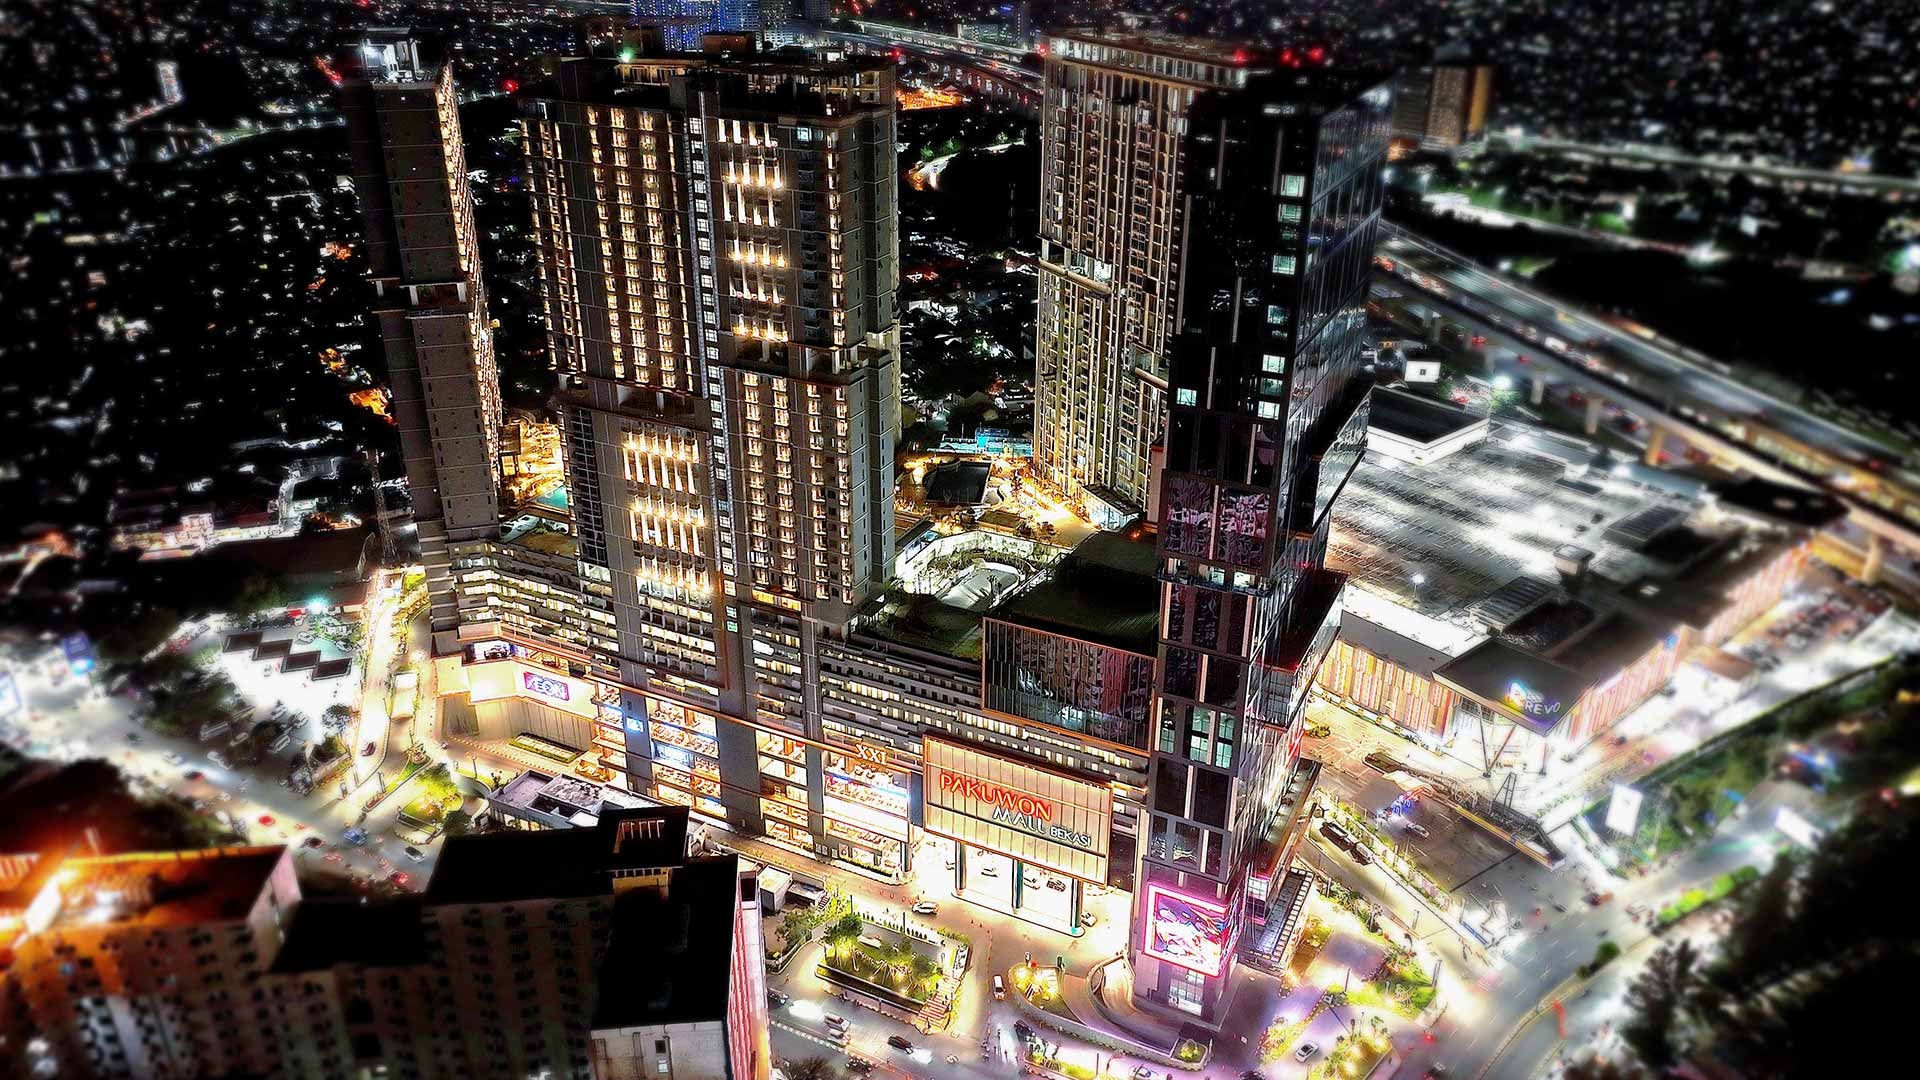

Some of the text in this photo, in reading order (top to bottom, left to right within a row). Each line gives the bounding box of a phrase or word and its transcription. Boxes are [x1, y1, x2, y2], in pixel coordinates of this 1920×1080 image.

[1525, 700, 1561, 715] REVO
[856, 743, 887, 765] XXI
[939, 773, 1053, 822] PAKUWON
[992, 805, 1092, 848] MALL BEKASI
